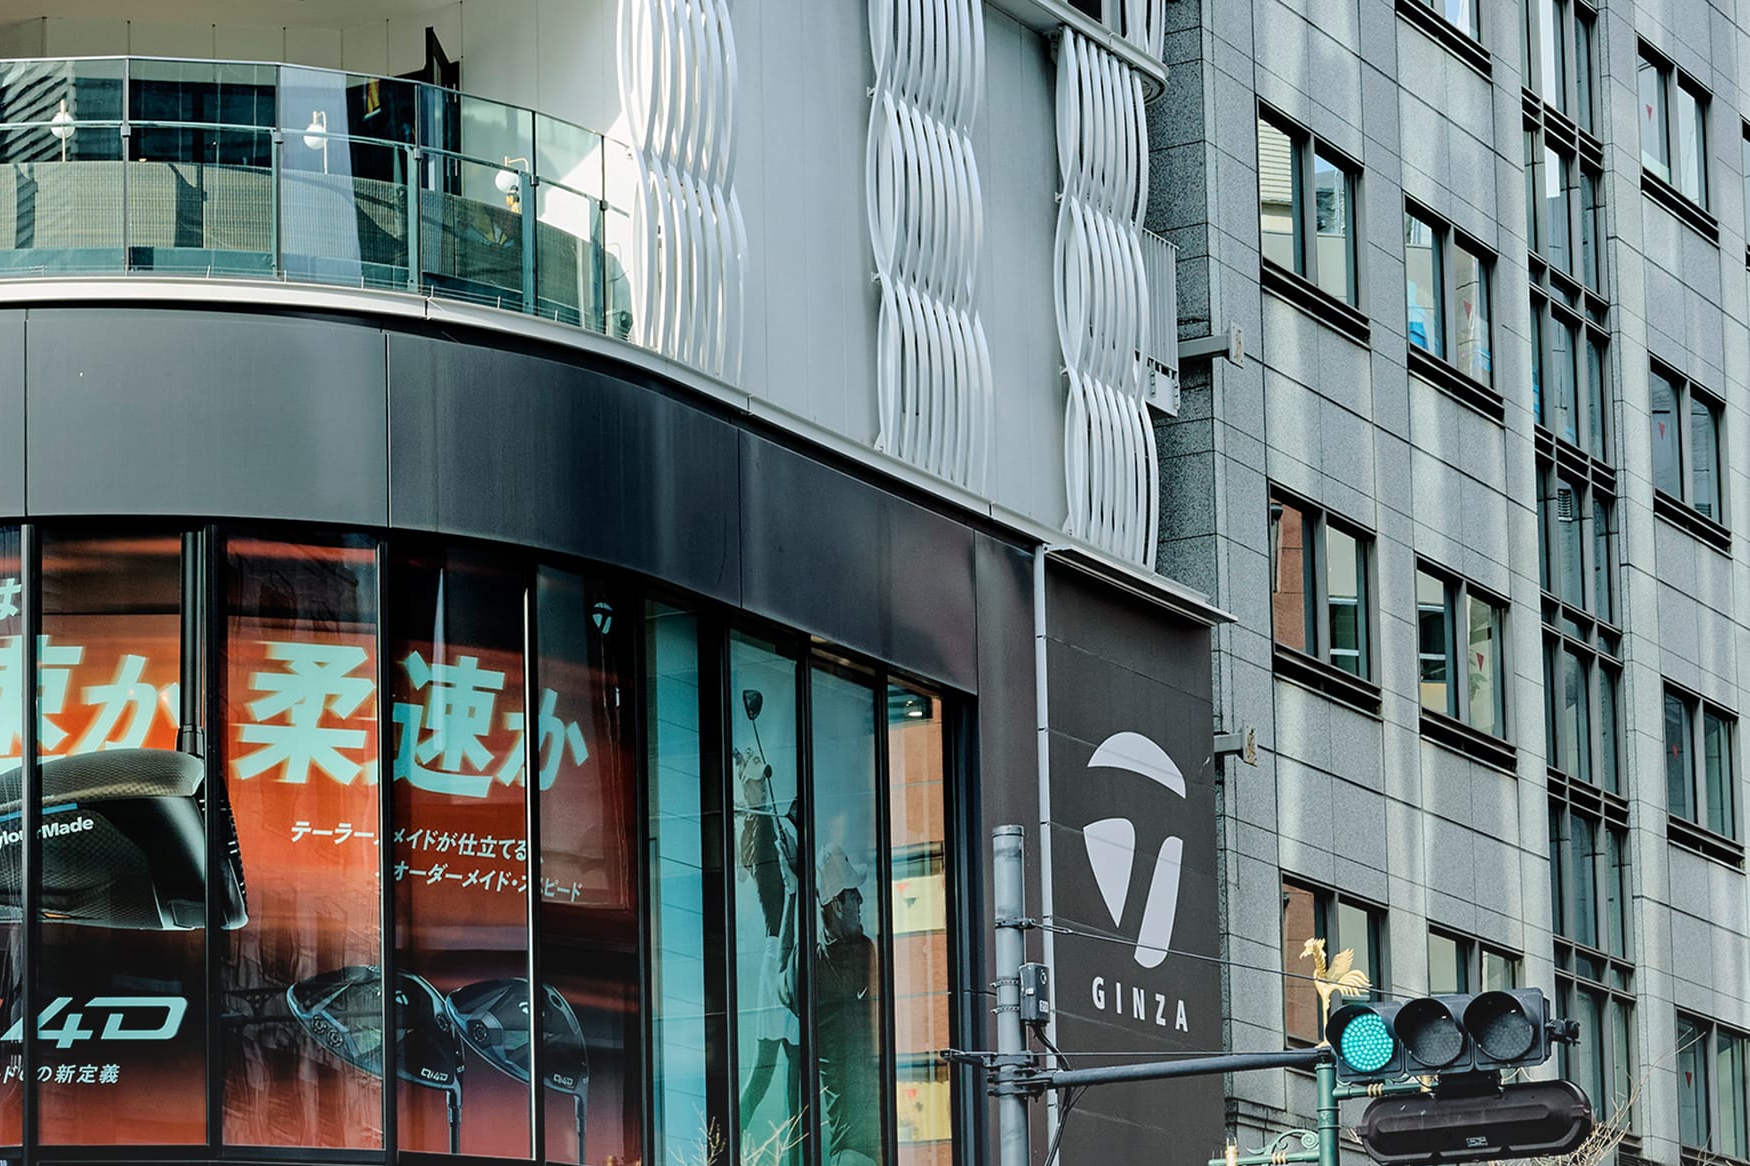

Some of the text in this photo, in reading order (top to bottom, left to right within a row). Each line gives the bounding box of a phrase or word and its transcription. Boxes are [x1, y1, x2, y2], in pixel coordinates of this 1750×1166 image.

[227, 640, 590, 799] 柔速か
[1092, 976, 1189, 1033] GINZA
